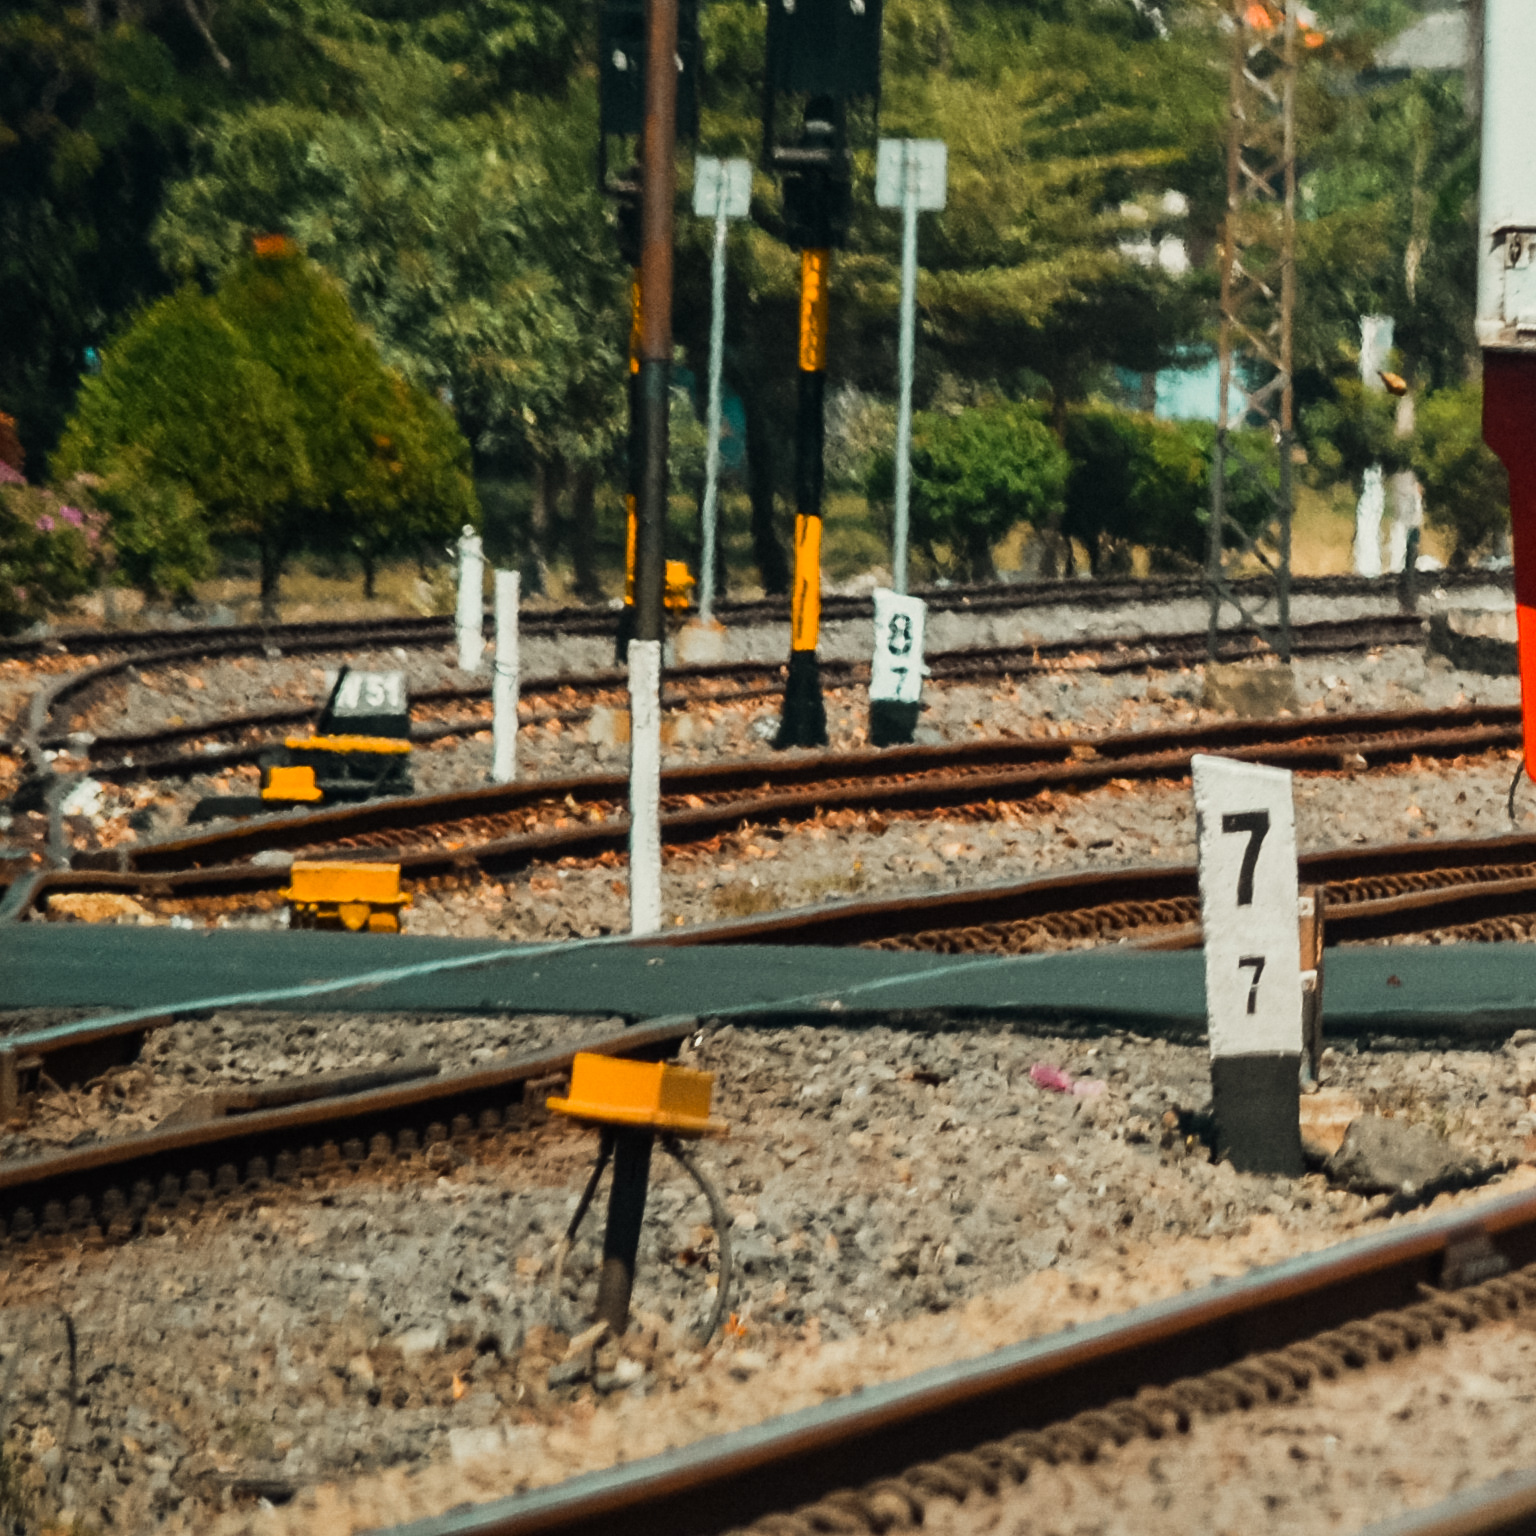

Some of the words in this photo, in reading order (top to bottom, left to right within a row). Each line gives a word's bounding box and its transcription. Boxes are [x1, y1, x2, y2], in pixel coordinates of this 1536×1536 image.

[888, 613, 913, 656] 8
[1221, 809, 1270, 906] 7
[1238, 955, 1266, 1015] 7
